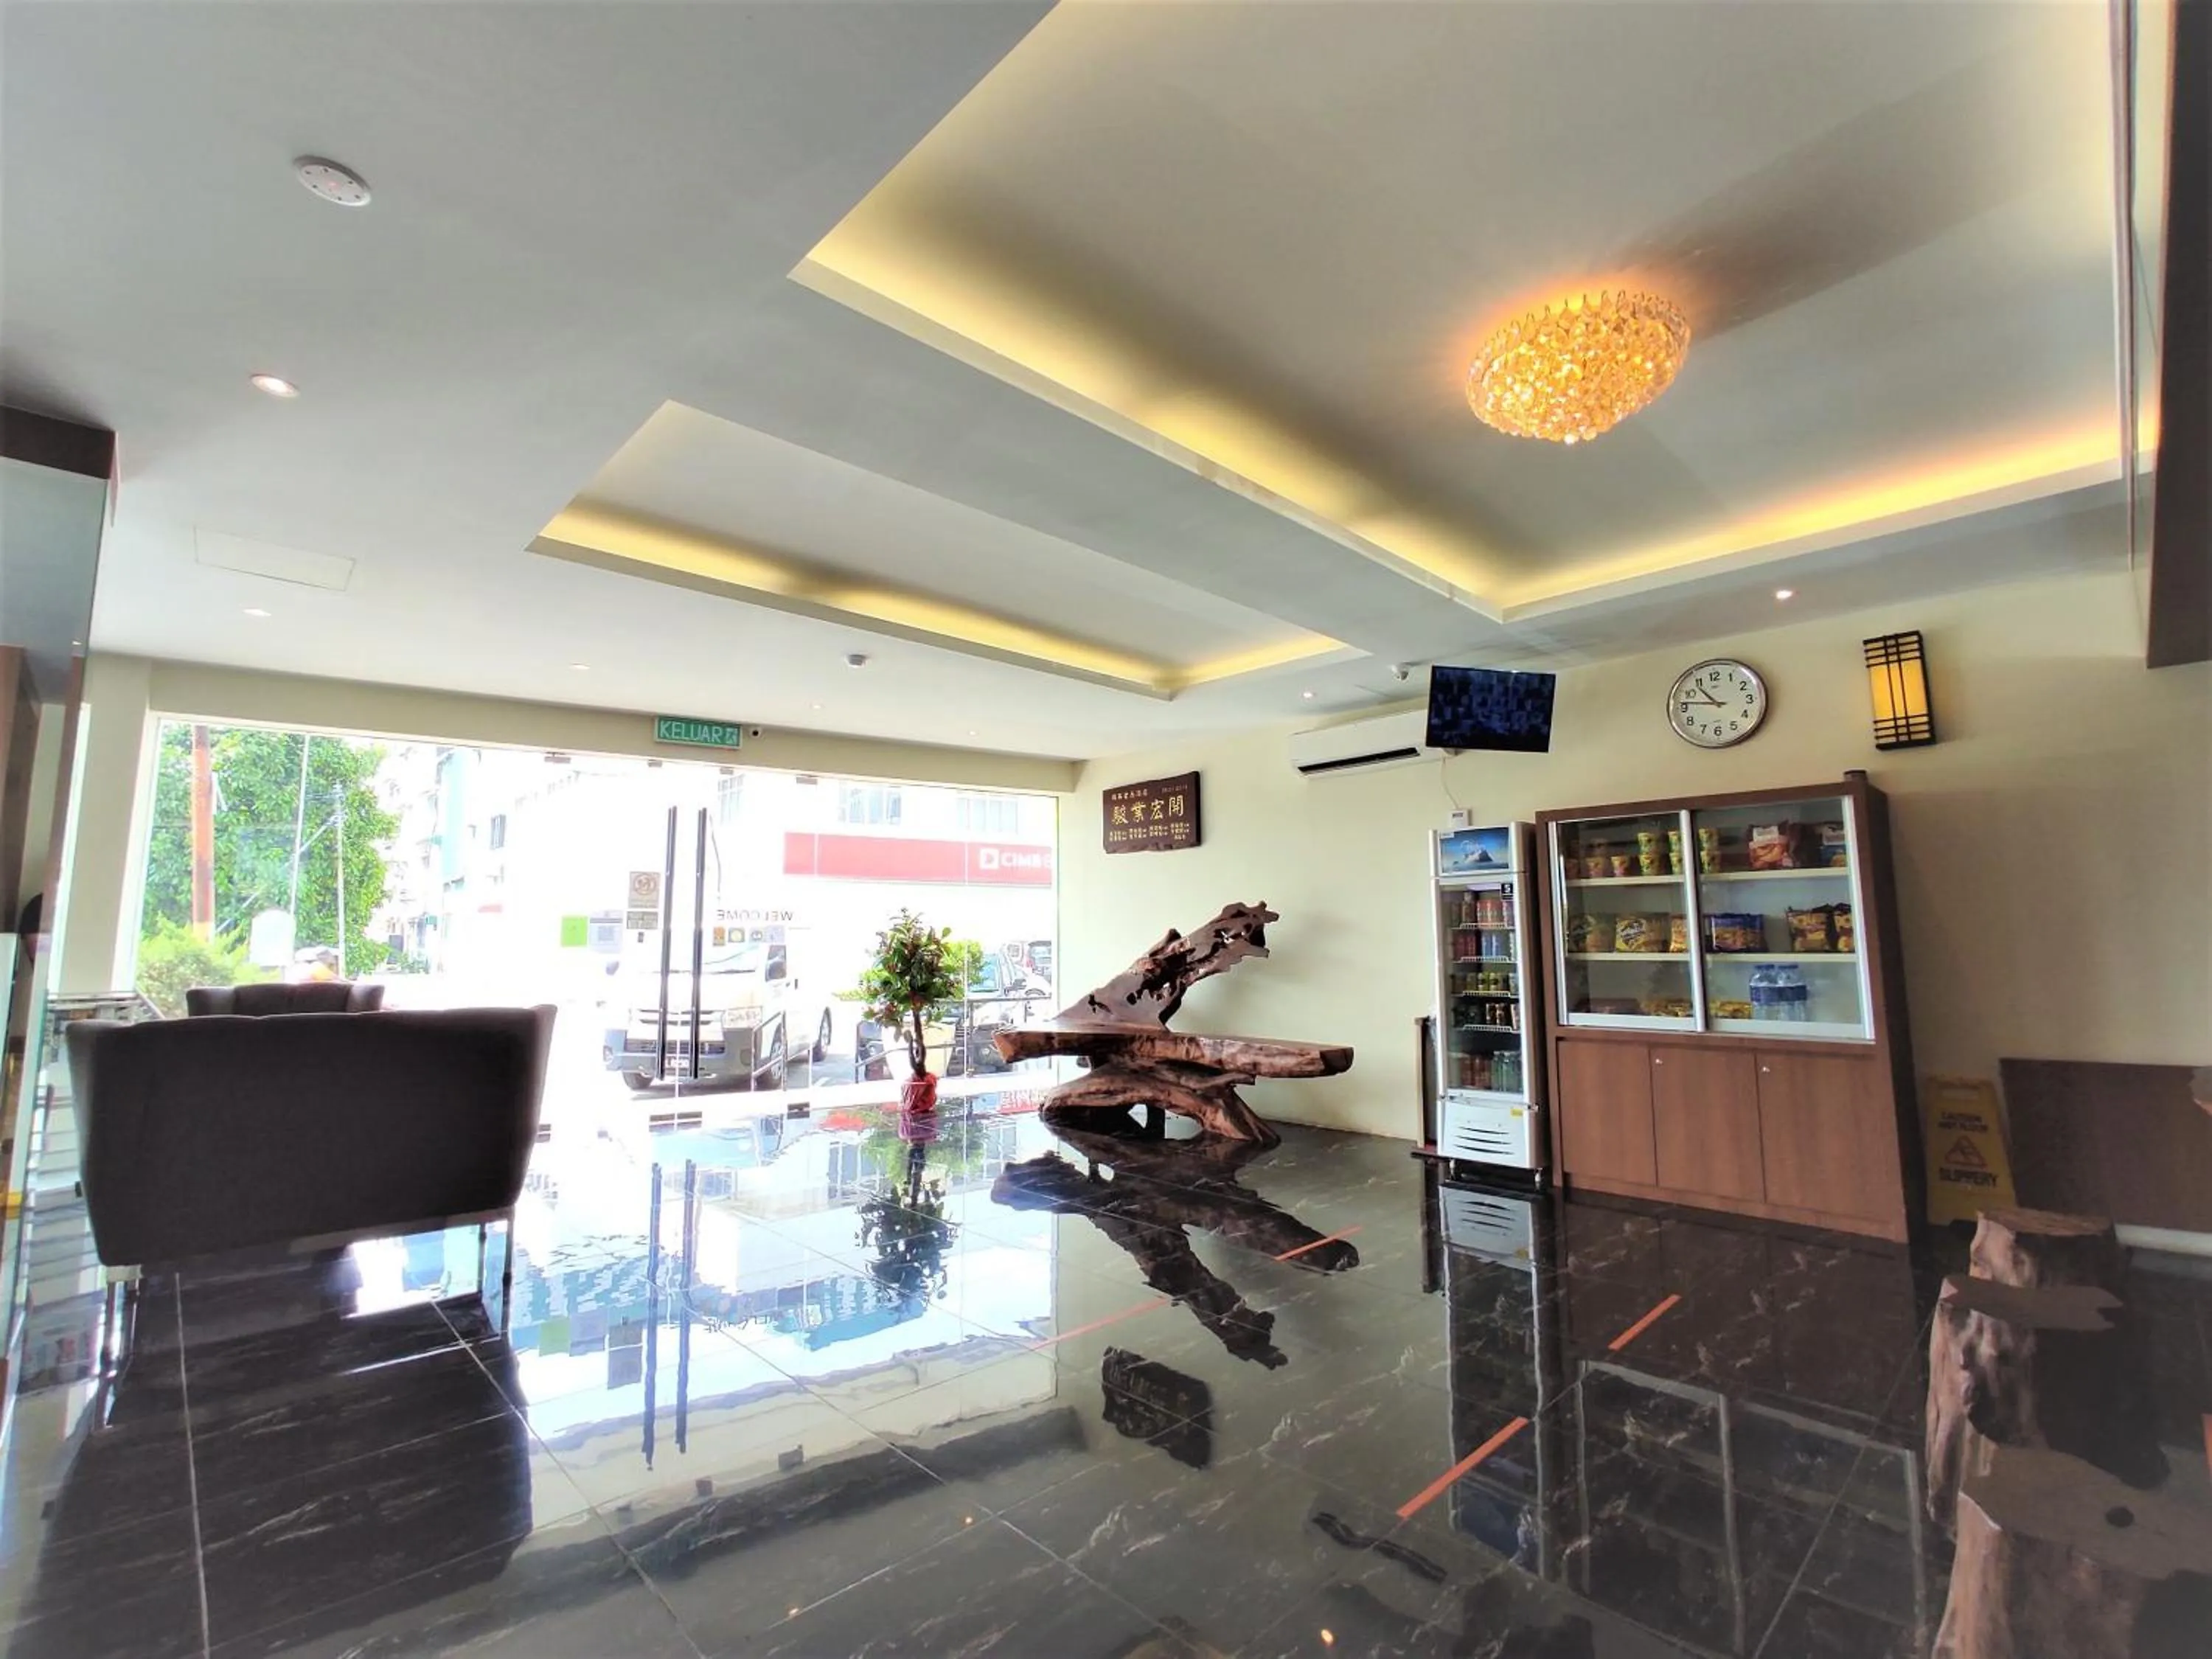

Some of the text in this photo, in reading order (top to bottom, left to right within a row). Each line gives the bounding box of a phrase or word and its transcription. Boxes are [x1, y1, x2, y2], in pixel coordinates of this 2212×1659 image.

[1709, 672, 1720, 681] 12
[1728, 673, 1733, 682] 1
[1696, 678, 1703, 687] 11
[1739, 681, 1747, 691] 2
[1686, 689, 1696, 699] 10
[1746, 695, 1754, 704] 3
[1680, 703, 1688, 713] 9
[1741, 709, 1748, 718] 4
[1687, 717, 1694, 726] 8
[1730, 721, 1738, 731] 5
[660, 720, 723, 743] KELUAR
[1700, 725, 1707, 734] 7
[1714, 727, 1722, 737] 6
